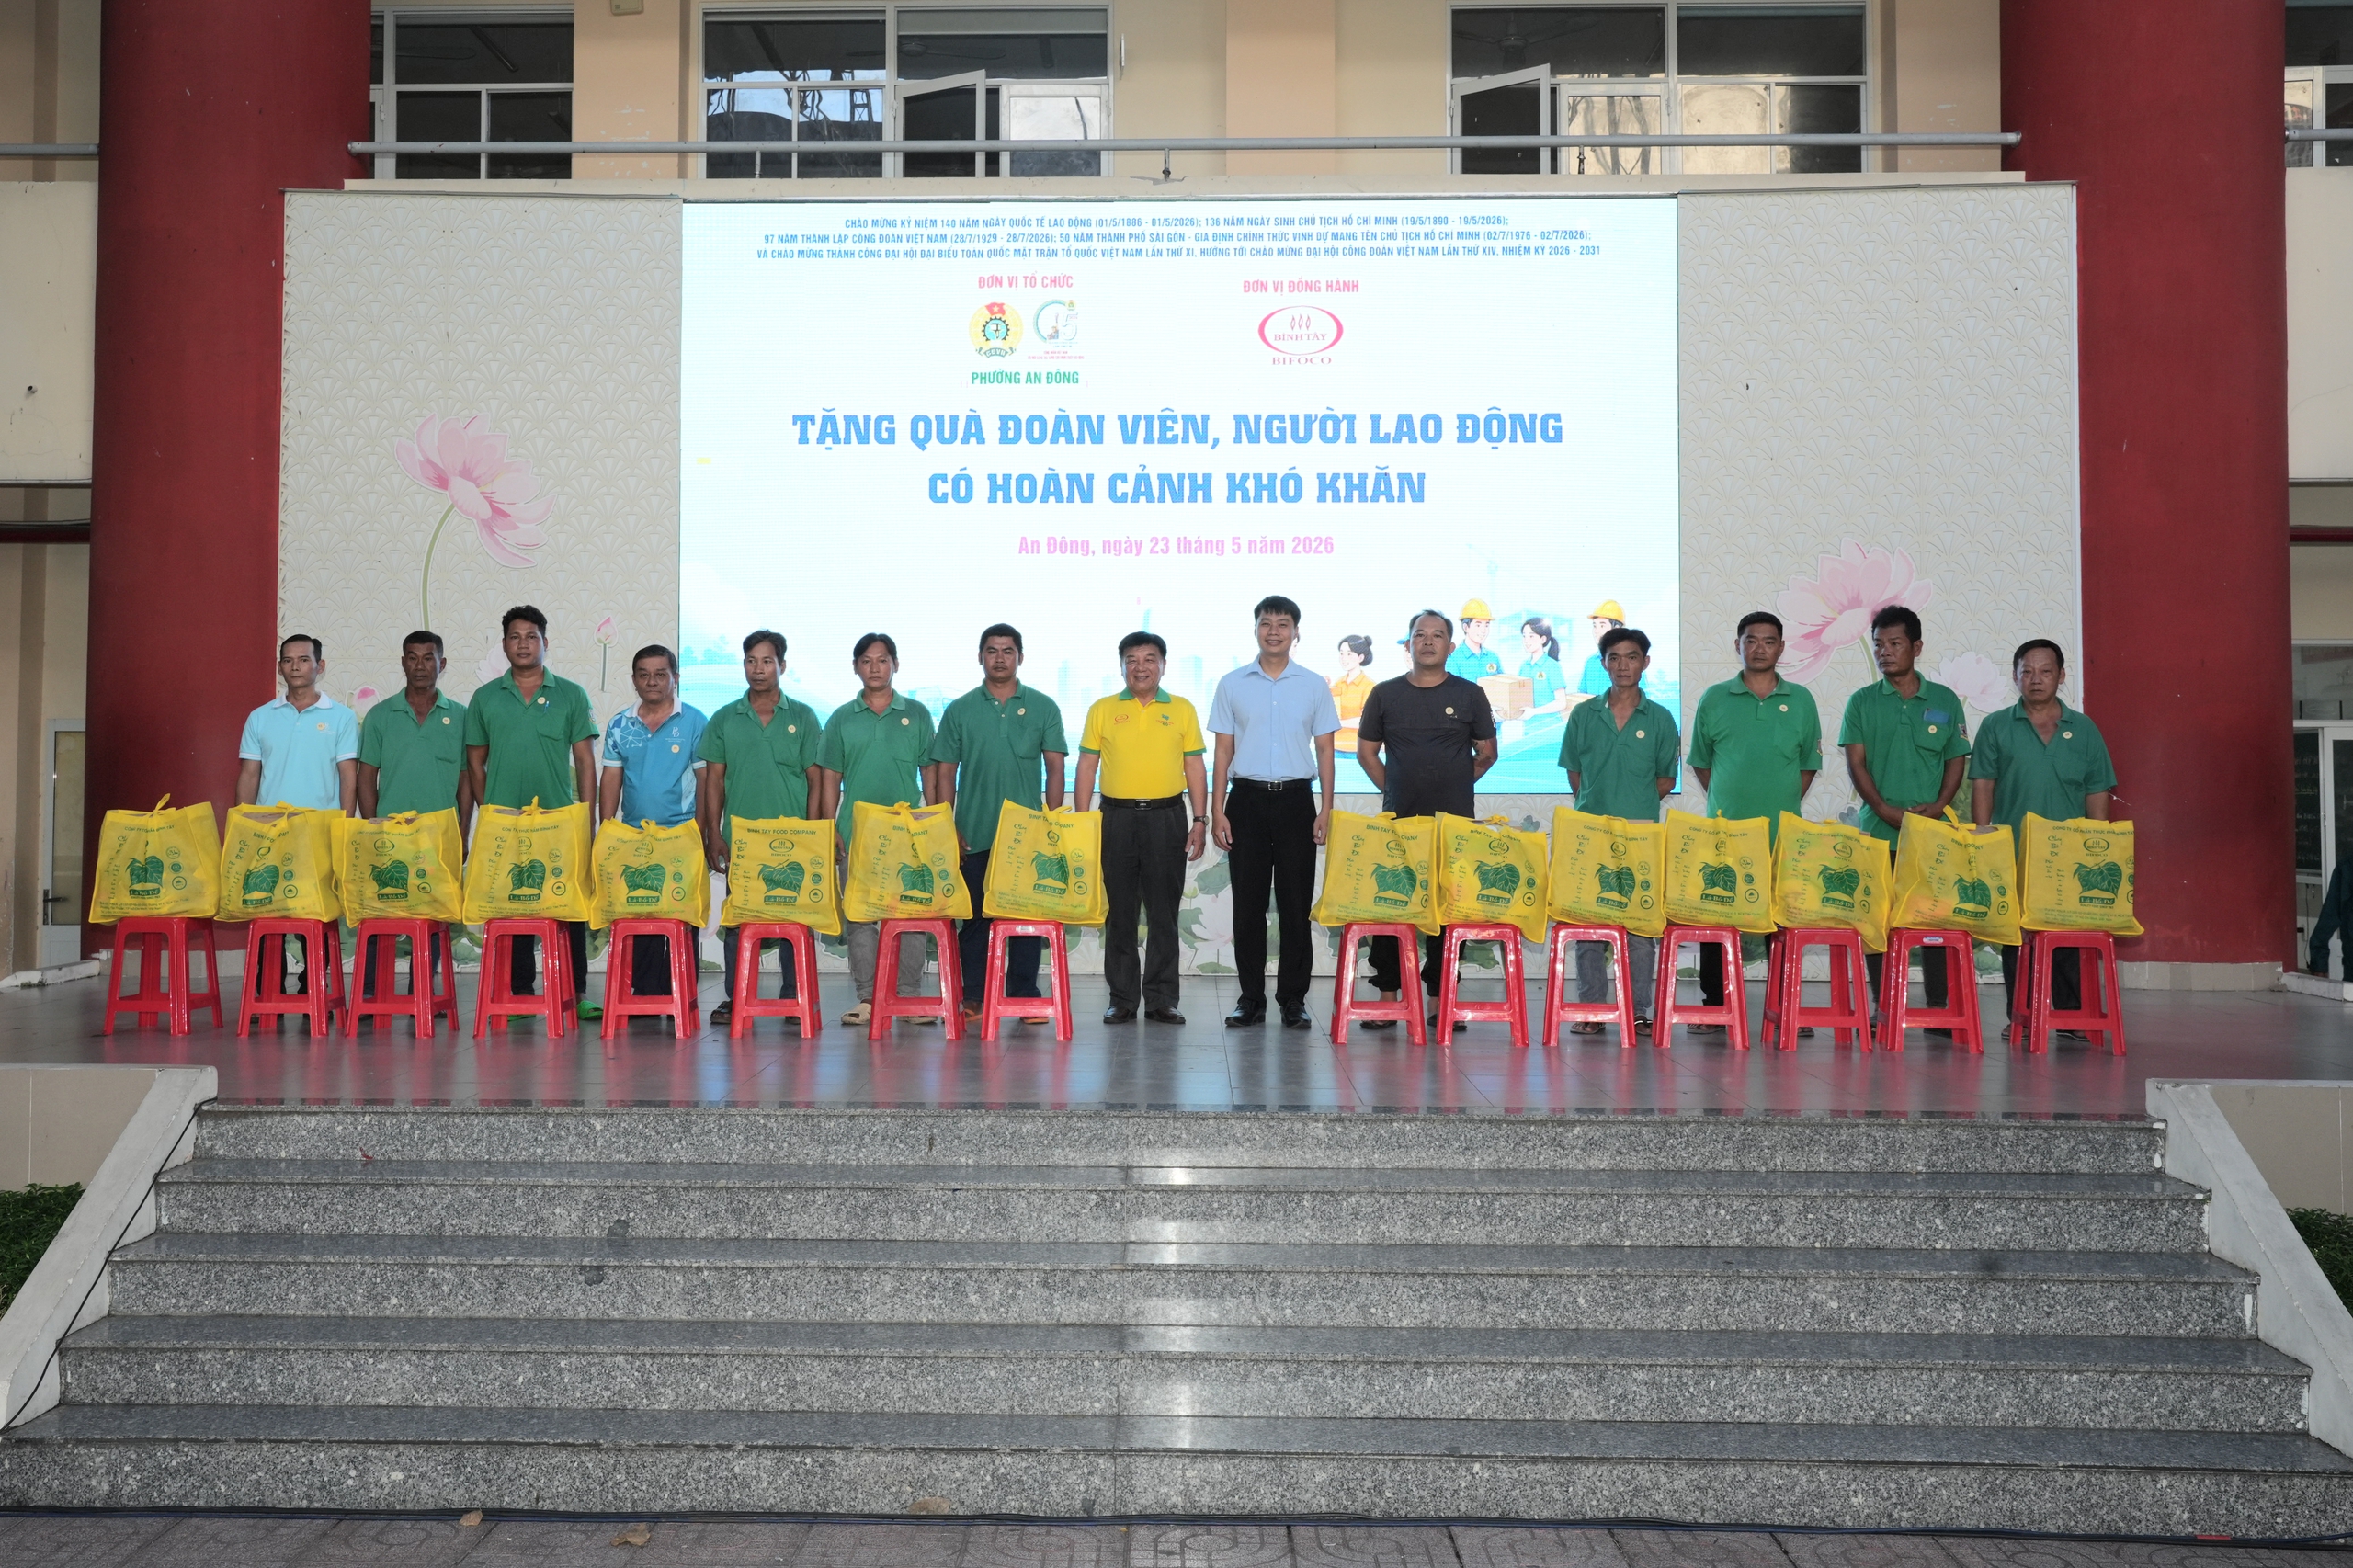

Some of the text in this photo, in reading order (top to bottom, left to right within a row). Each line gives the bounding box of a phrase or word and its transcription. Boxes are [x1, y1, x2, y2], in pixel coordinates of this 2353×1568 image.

[844, 216, 868, 228] CHÀO
[900, 215, 912, 228] KỶ
[940, 218, 956, 228] 140
[958, 215, 980, 228] NĂM
[982, 215, 1006, 228] NGÀY
[1047, 218, 1064, 227] LAO
[1204, 217, 1221, 226] 136
[1222, 214, 1245, 226] NĂM
[1246, 214, 1270, 226] NGÀY
[1273, 216, 1295, 226] SINH
[1298, 212, 1315, 225] CHỦ
[1318, 216, 1338, 228] TỊCH
[1356, 213, 1371, 225] CHÍ
[1373, 216, 1398, 225] MINH
[764, 234, 775, 244] 97
[777, 232, 799, 244] NĂM
[801, 232, 830, 244] THÀNH
[851, 232, 876, 244] CÔNG
[878, 232, 903, 244] ĐOÀN
[926, 233, 948, 243] NAM
[1059, 233, 1070, 243] 50
[1073, 231, 1094, 243] NĂM
[1096, 231, 1125, 243] THÀNH
[1148, 230, 1164, 242] SÀI
[1166, 230, 1186, 242] GÒN
[1194, 233, 1210, 242] GIA
[1211, 233, 1233, 244] ĐỊNH
[1236, 230, 1264, 242] CHÍNH
[1291, 232, 1313, 241] VINH
[1330, 232, 1358, 241] MANG
[1359, 229, 1377, 241] TÊN
[1380, 228, 1397, 241] CHỦ
[1400, 232, 1421, 244] TỊCH
[1438, 228, 1453, 241] CHÍ
[1456, 231, 1480, 241] MINH
[756, 246, 768, 259] VÀ
[770, 246, 795, 259] CHÀO
[825, 246, 856, 259] THÀNH
[858, 246, 882, 259] CÔNG
[884, 249, 900, 261] ĐẠI
[919, 249, 935, 261] ĐẠI
[961, 246, 983, 258] TOÀN
[1121, 248, 1142, 257] NAM
[1249, 244, 1274, 257] CHÀO
[1305, 247, 1321, 259] ĐẠI
[1341, 244, 1366, 256] CÔNG
[1369, 244, 1393, 256] ĐOÀN
[1417, 246, 1439, 256] NAM
[1533, 244, 1545, 256] KỲ
[1548, 245, 1570, 256] 2026
[1578, 245, 1600, 256] 2031
[978, 271, 1074, 291] ĐƠN VỊ TỔ CHỨC
[1244, 279, 1268, 292] ĐƠN
[1273, 280, 1284, 296] VỊ
[1326, 278, 1359, 292] HÀNH
[1272, 357, 1332, 366] BIFOCO
[972, 369, 1079, 385] PHƯỜNG AN ĐÔNG
[792, 406, 1563, 451] TẶNG QUÀ ĐOÀN VIÊN, NGƯỜI LAO ĐỘNG
[928, 463, 1427, 504] CÓ HOÀN CẢNH KHÓ KHĂN
[1018, 536, 1334, 557] An Đông, ngày 23 tháng 5 năm 2026
